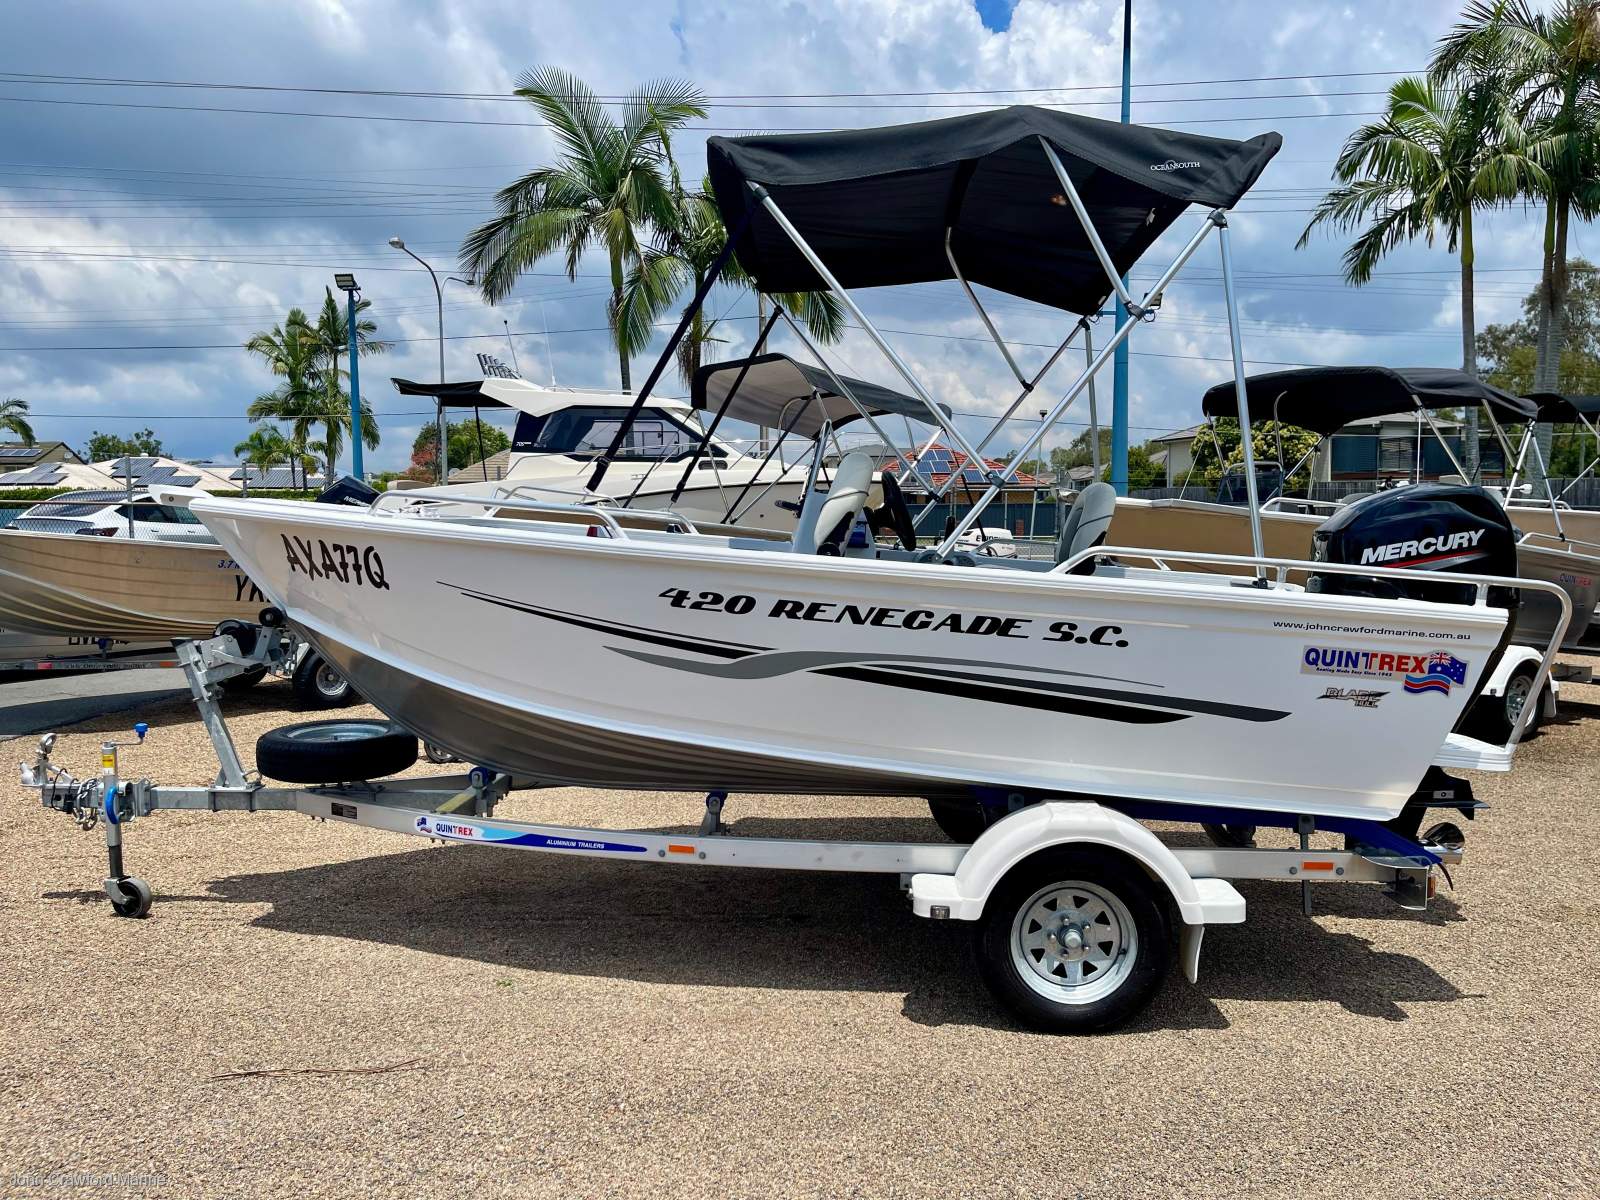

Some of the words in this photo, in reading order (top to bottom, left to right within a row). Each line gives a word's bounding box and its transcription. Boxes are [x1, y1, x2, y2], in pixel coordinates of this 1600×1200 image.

[1150, 160, 1201, 172] OCEANSOUTH
[1360, 529, 1485, 564] MERCURY
[280, 533, 390, 590] AXA77Q
[658, 587, 757, 615] 420
[767, 599, 1033, 639] RENEGADE
[1042, 622, 1129, 648] S.C.
[1273, 620, 1471, 640] www.johncrawfordmarine.com.au
[1304, 648, 1427, 674] QUINTREX
[436, 823, 473, 836] QUINTREX
[546, 839, 577, 847] ALUMINIUM
[577, 841, 605, 849] TRAILERS
